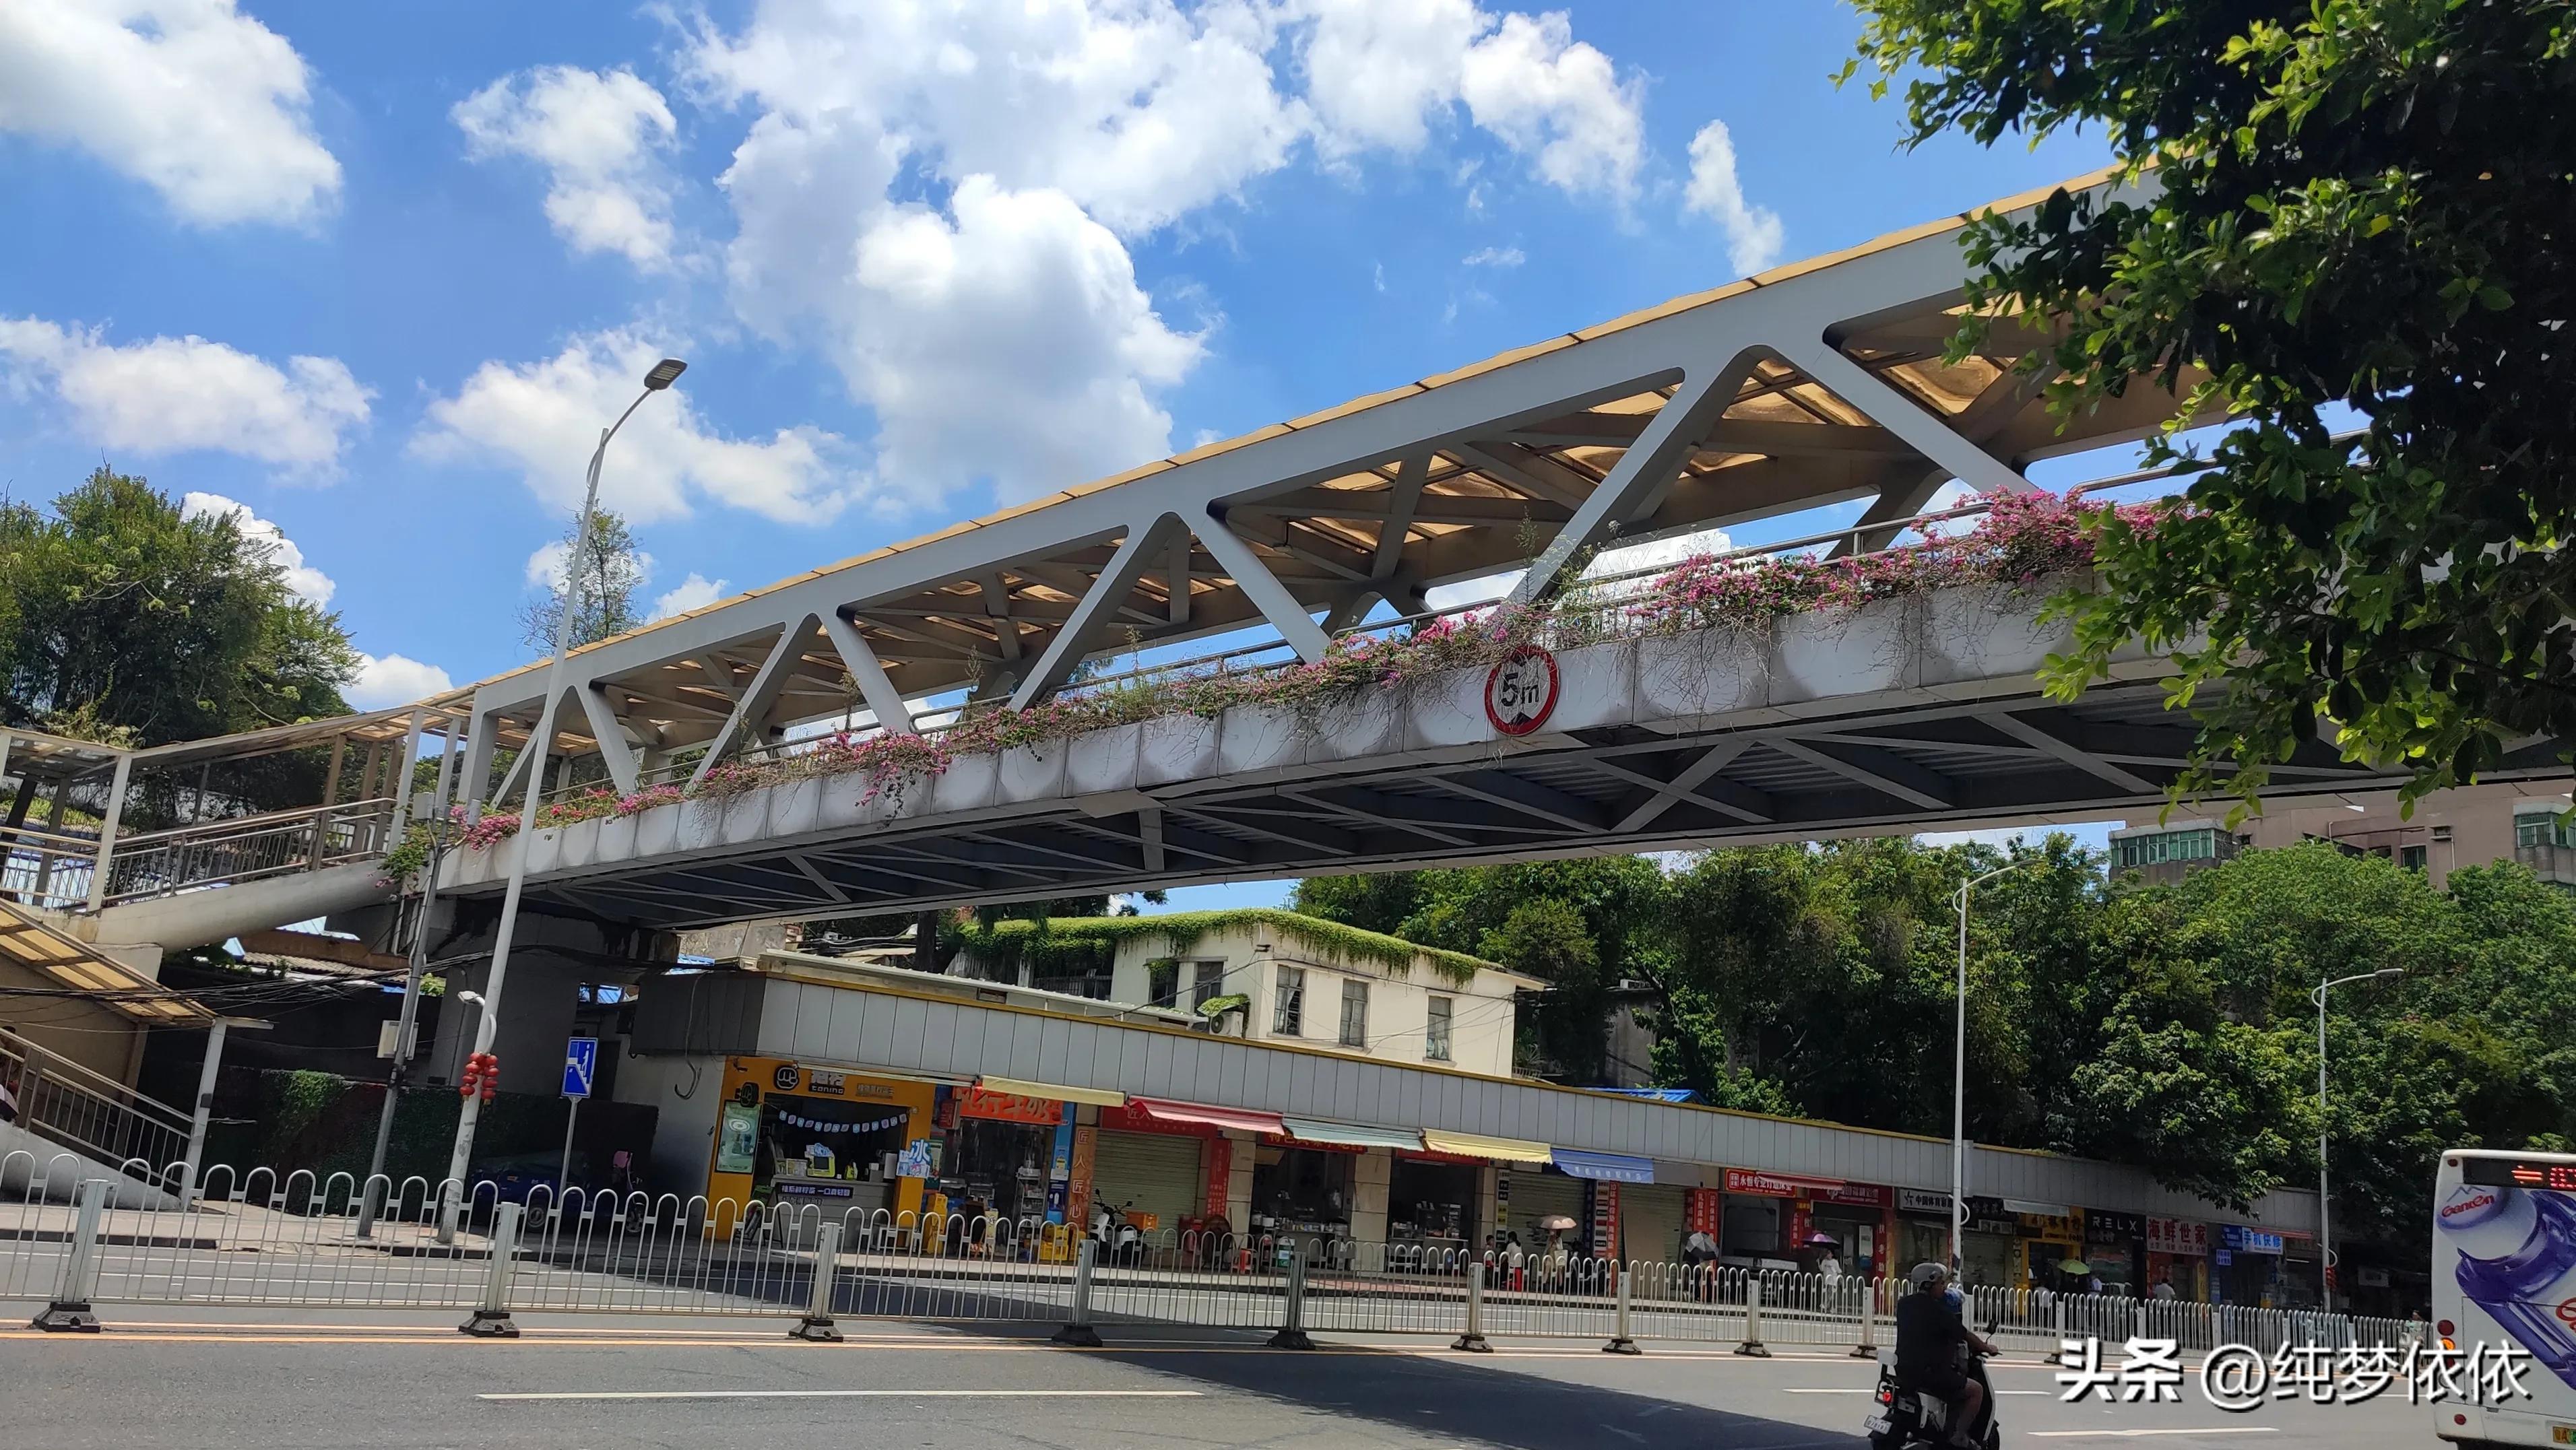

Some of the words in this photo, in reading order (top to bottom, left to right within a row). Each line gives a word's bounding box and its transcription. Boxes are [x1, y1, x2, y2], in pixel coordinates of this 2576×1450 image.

[1501, 673, 1539, 706] 5m
[2092, 1216, 2137, 1232] RELX
[2148, 1218, 2206, 1245] 海鲜世家
